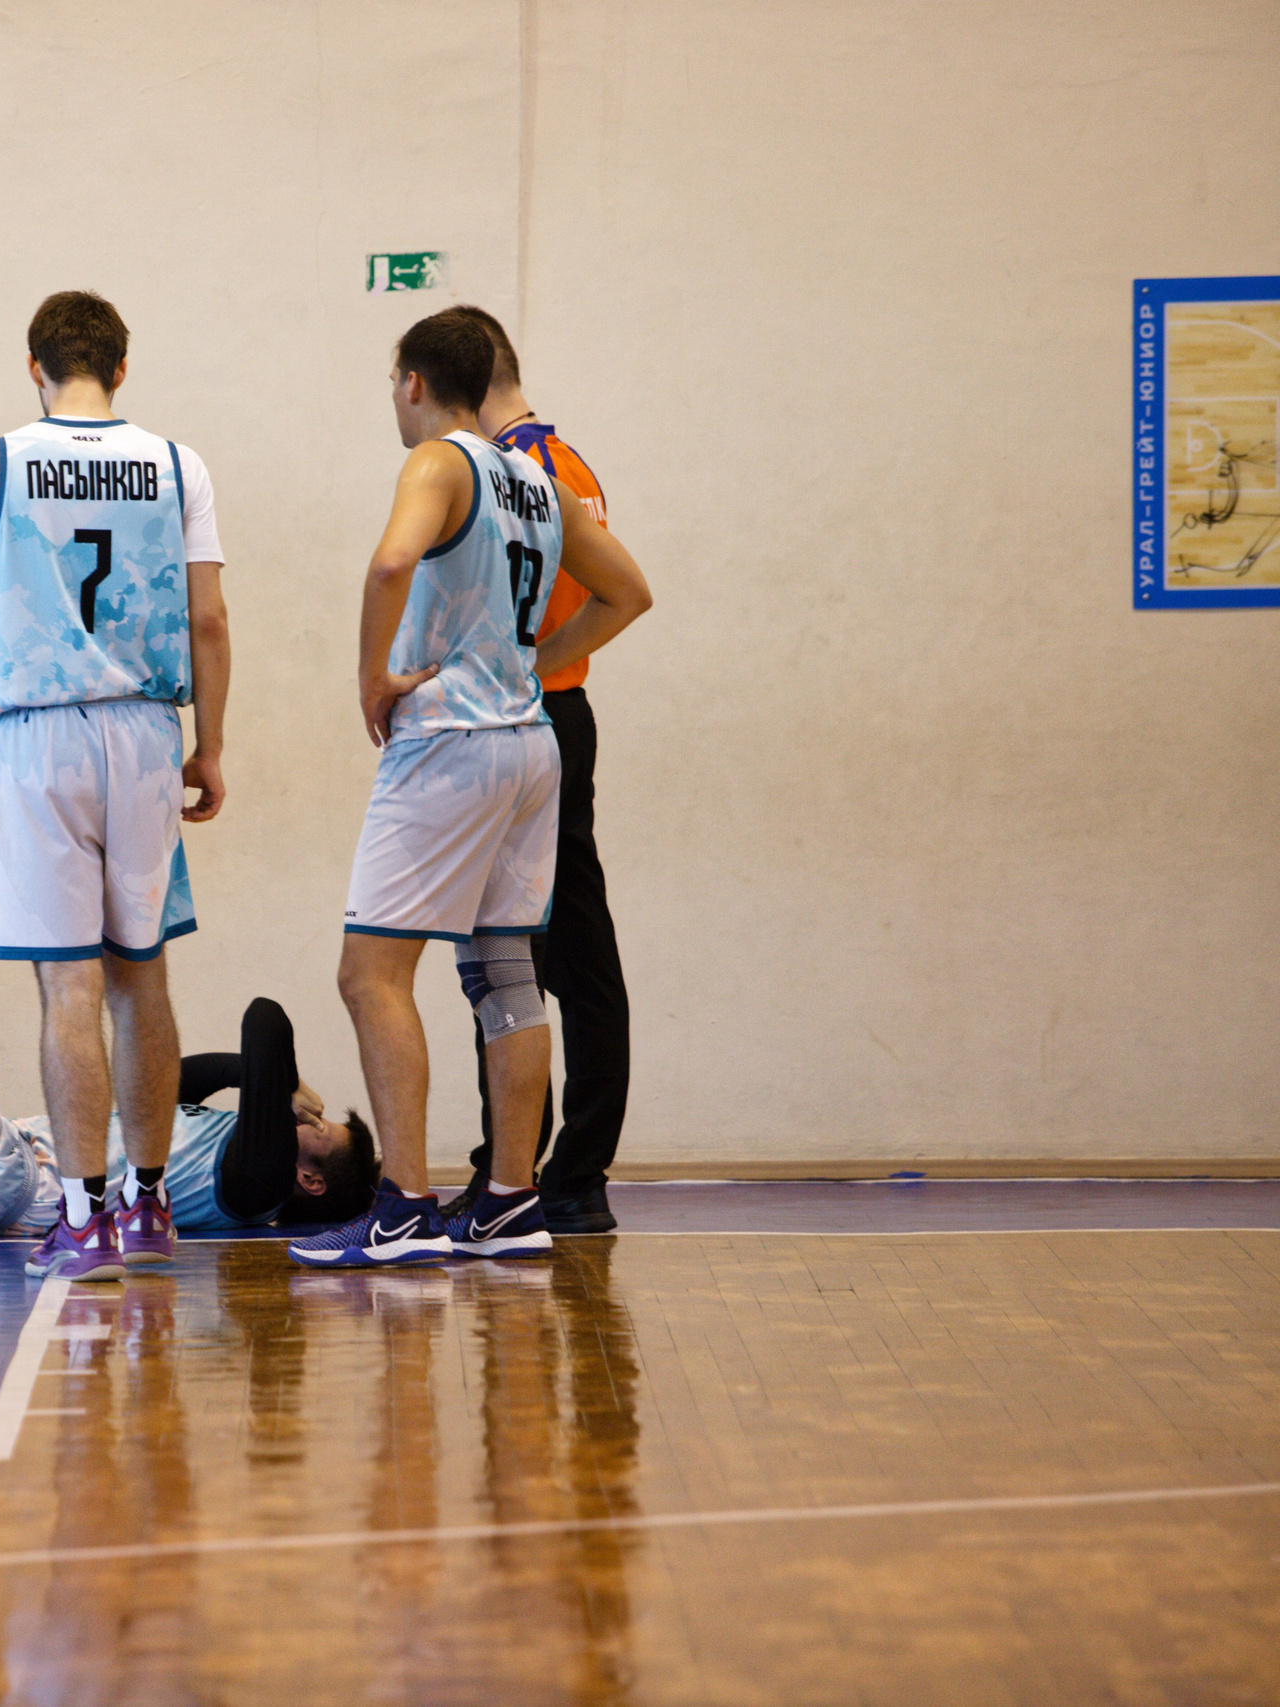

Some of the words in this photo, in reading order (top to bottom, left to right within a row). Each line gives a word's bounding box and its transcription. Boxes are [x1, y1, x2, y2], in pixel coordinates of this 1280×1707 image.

[26, 459, 158, 501] ПАСЫНКОВ
[1137, 303, 1155, 588] УРАЛ-ГРЕЙТ-ЮНИОР
[74, 529, 112, 634] 7
